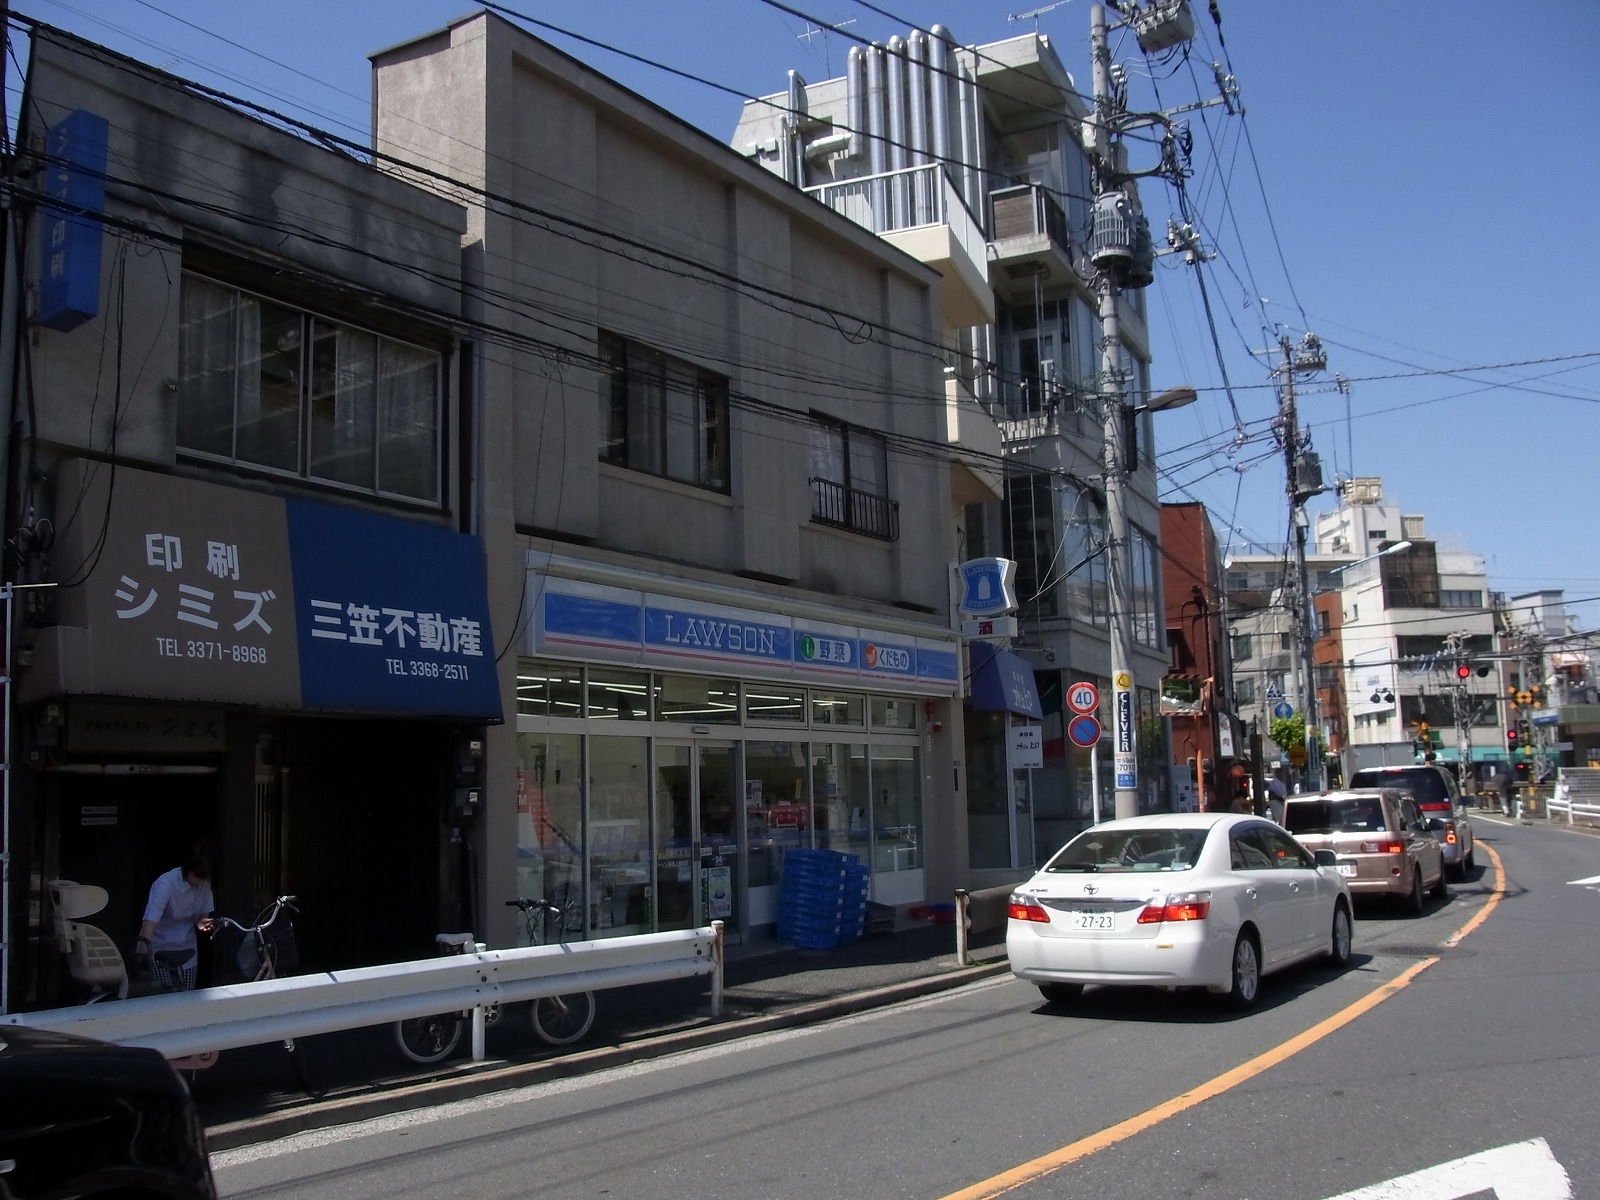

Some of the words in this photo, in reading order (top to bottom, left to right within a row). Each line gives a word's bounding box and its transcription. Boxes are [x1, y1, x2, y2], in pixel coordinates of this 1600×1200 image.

[145, 533, 241, 581] 印刷
[114, 574, 278, 635] シミズ
[310, 599, 484, 658] 三笠不動産
[664, 613, 776, 655] LAWSON
[978, 620, 994, 635] 酒
[156, 636, 183, 657] TEL
[187, 641, 267, 664] 3371-8968
[819, 640, 846, 662] 野菜
[879, 648, 908, 669] くだもの
[385, 658, 408, 676] TEL
[410, 660, 470, 681] 3368-2511
[1075, 691, 1092, 705] 40
[1119, 692, 1130, 752] CLEVER
[1081, 916, 1112, 928] 27-23
